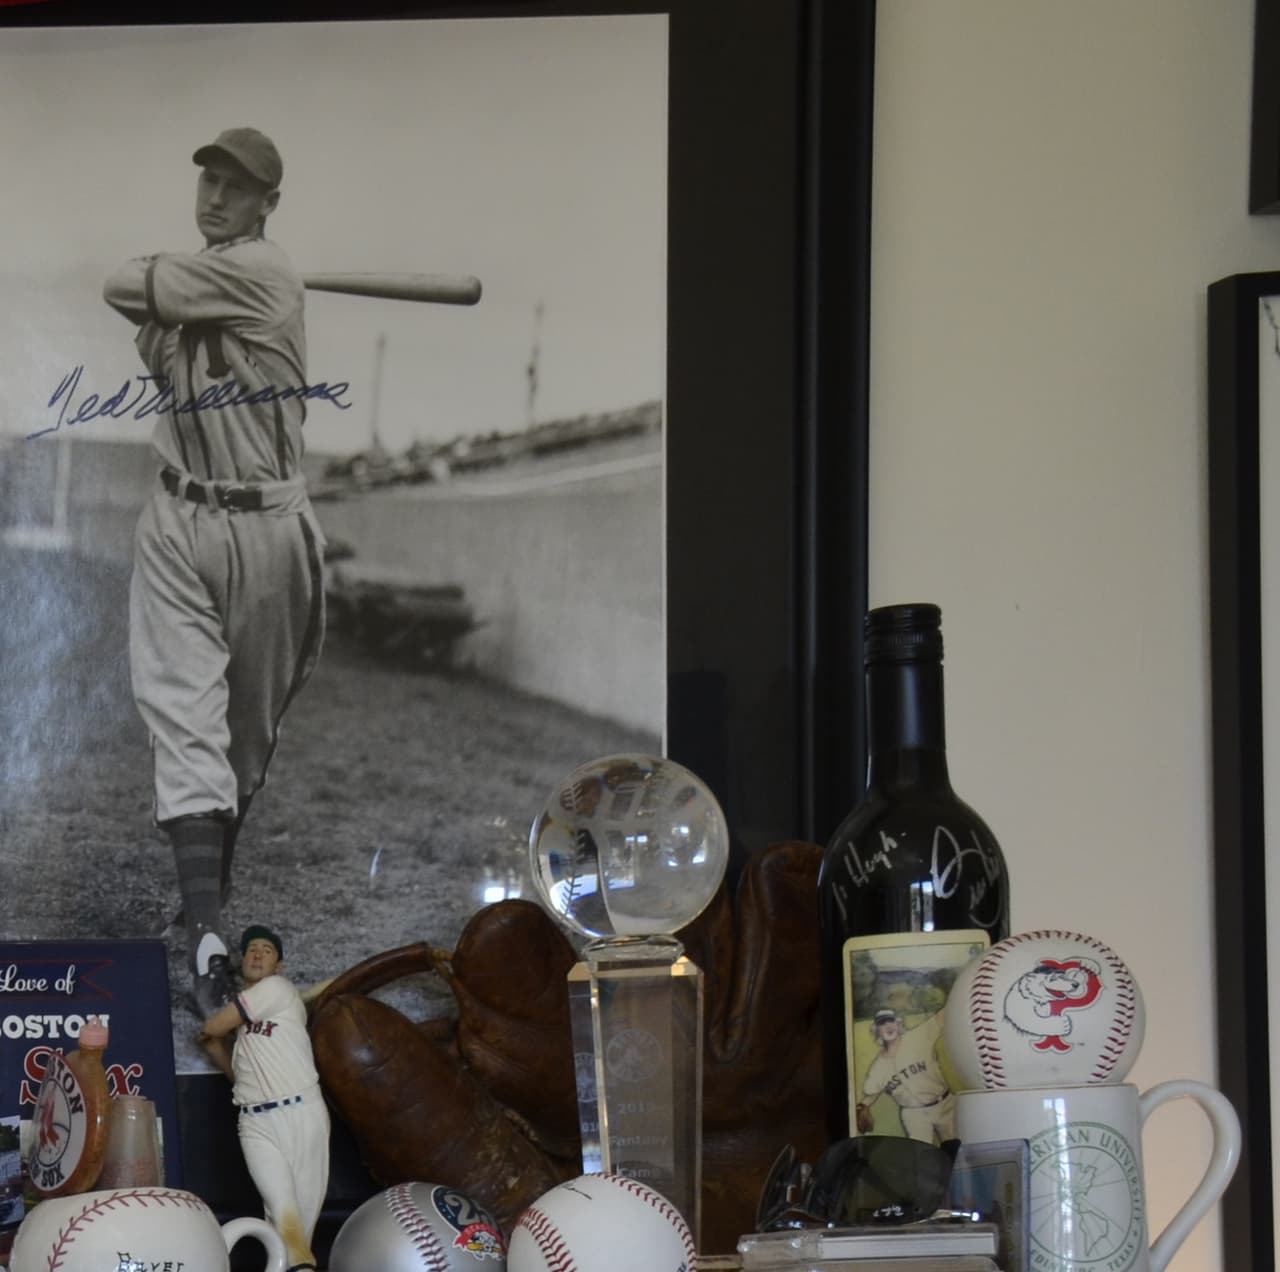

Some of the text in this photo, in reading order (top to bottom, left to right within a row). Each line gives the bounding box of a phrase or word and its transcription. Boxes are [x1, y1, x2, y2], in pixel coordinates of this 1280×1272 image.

[54, 964, 77, 995] of
[20, 1046, 143, 1105] Sx
[41, 1162, 65, 1188] SOX
